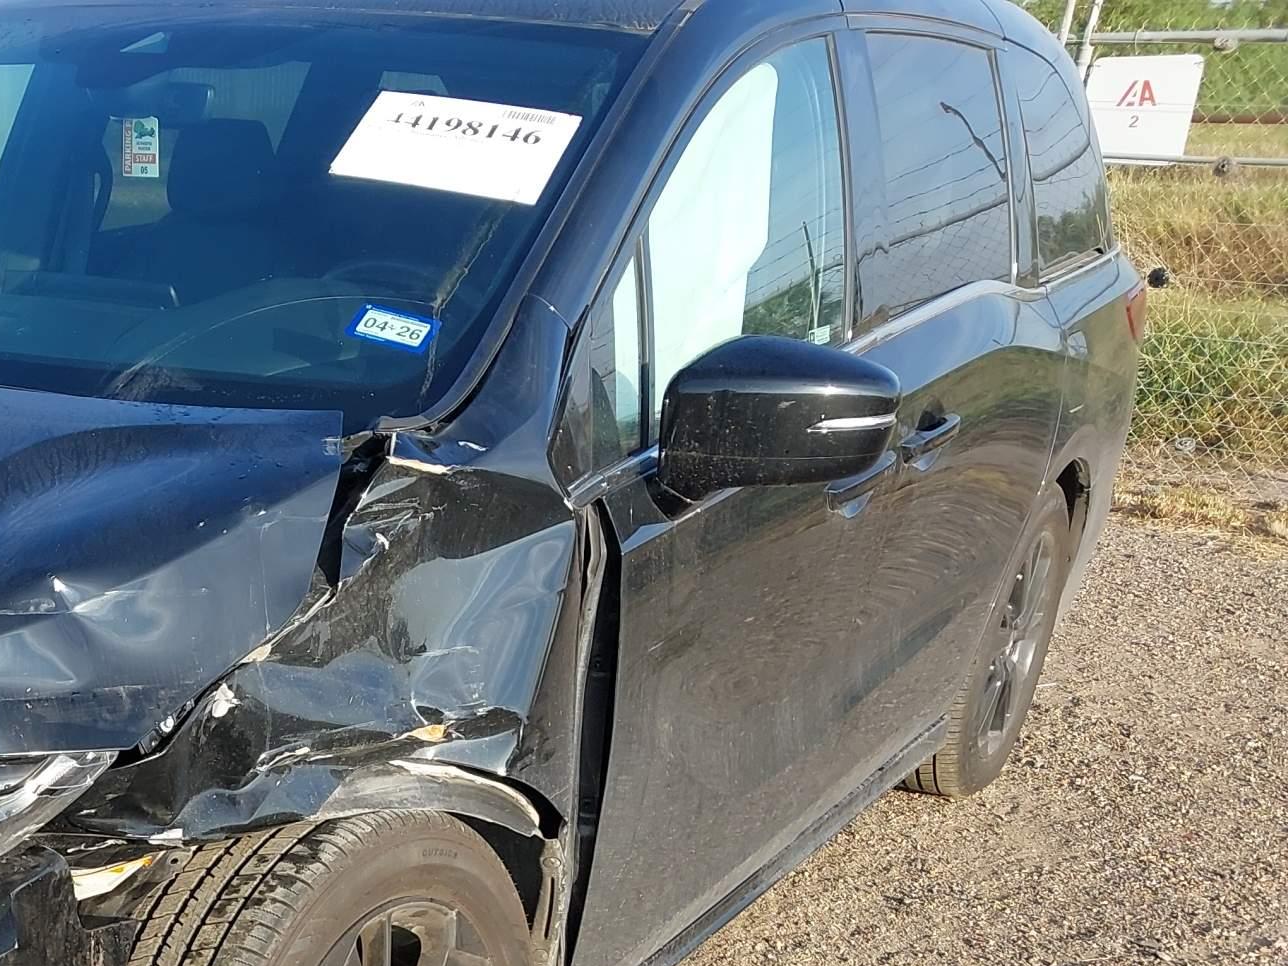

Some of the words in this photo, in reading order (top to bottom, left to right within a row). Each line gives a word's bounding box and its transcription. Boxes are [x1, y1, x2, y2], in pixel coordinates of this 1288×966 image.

[1127, 115, 1140, 128] 2
[124, 130, 133, 173] PARKING
[135, 154, 154, 163] STAFF
[363, 317, 389, 332] 04
[395, 325, 423, 341] 26
